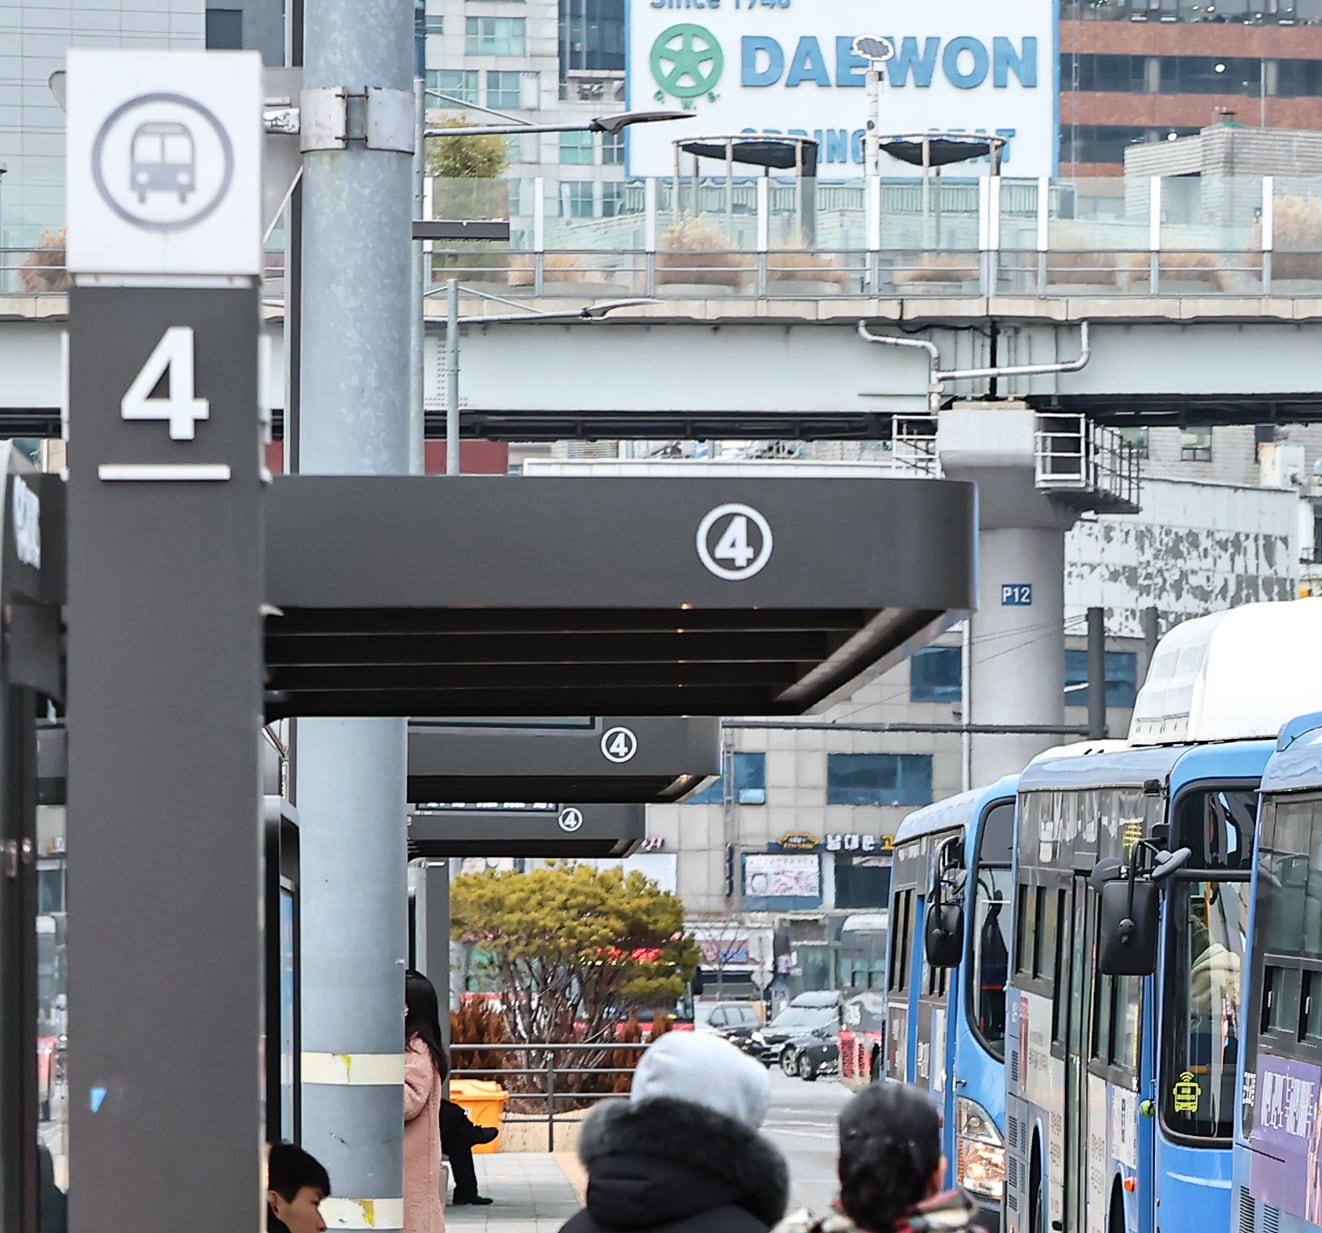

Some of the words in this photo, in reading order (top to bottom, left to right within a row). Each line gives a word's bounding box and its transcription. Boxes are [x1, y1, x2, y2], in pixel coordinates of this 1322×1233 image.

[740, 35, 1038, 89] DAEWON
[740, 128, 868, 164] ING
[121, 326, 210, 440] 4
[1003, 587, 1031, 603] P12
